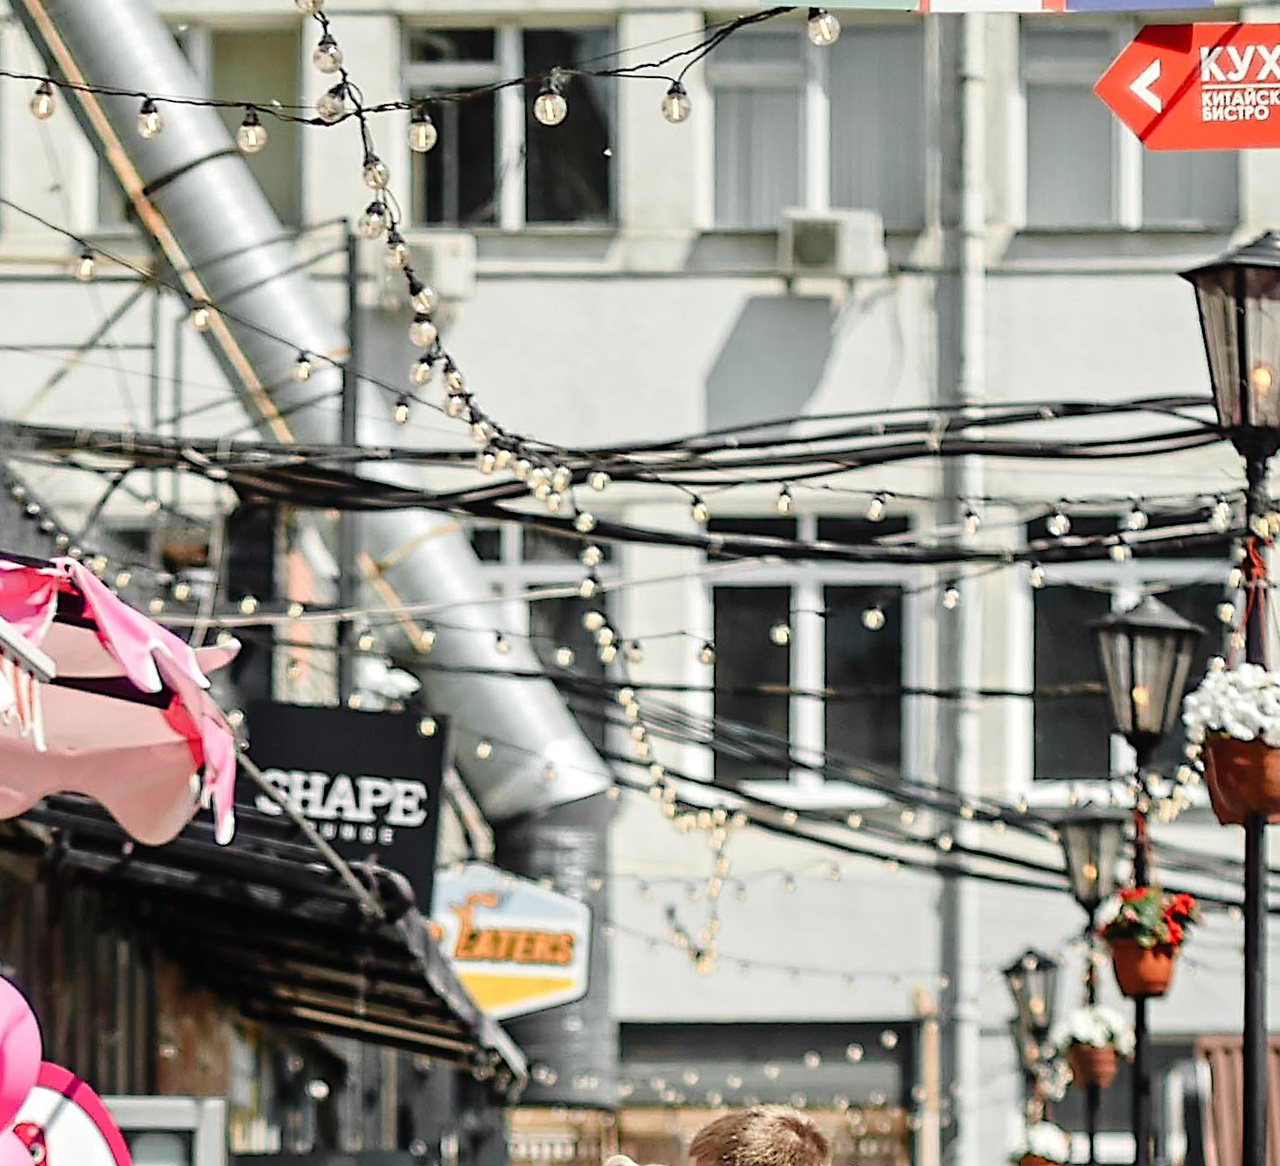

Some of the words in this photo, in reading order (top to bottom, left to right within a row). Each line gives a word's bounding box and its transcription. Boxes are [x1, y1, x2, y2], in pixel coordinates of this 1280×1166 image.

[1202, 105, 1270, 121] БИСТРО
[255, 769, 428, 826] SHAPE
[305, 819, 395, 846] UNGE
